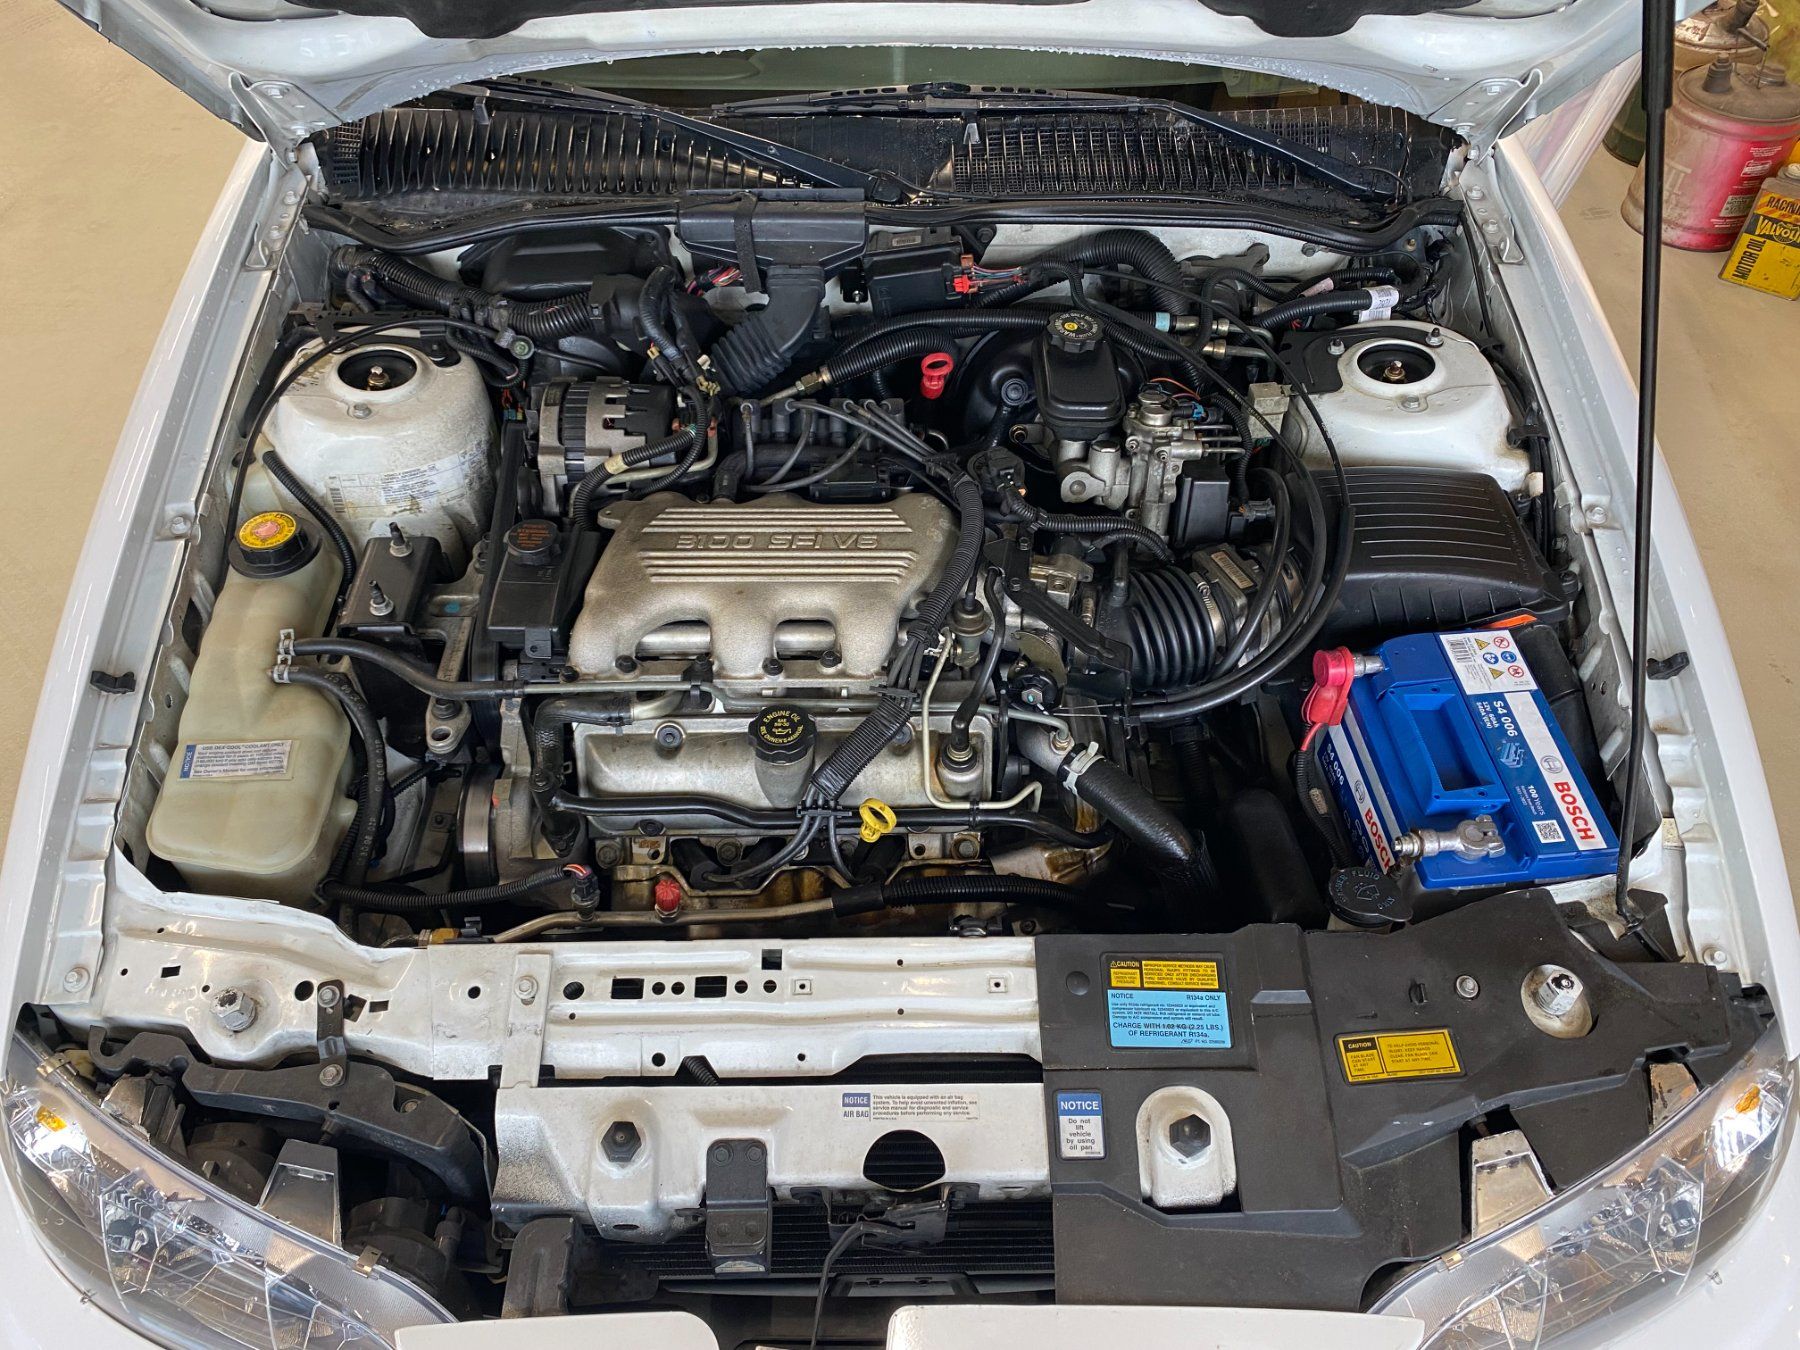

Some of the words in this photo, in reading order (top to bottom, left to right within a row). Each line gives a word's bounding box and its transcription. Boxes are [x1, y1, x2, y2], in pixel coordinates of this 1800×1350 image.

[1732, 251, 1759, 280] MOTOR
[1747, 238, 1766, 252] OIL
[676, 534, 754, 549] 3100
[768, 534, 823, 549] SFI
[833, 534, 878, 549] V6
[1483, 701, 1492, 713] 12V
[763, 710, 790, 722] ENGINE
[791, 713, 800, 722] OIL
[1493, 700, 1507, 714] S4
[1501, 716, 1518, 737] 006
[1528, 784, 1538, 798] 100
[1534, 797, 1546, 815] Years
[1554, 782, 1594, 840] BOSCH
[1352, 870, 1380, 880] FLUID
[1061, 1101, 1099, 1110] NOTICE
